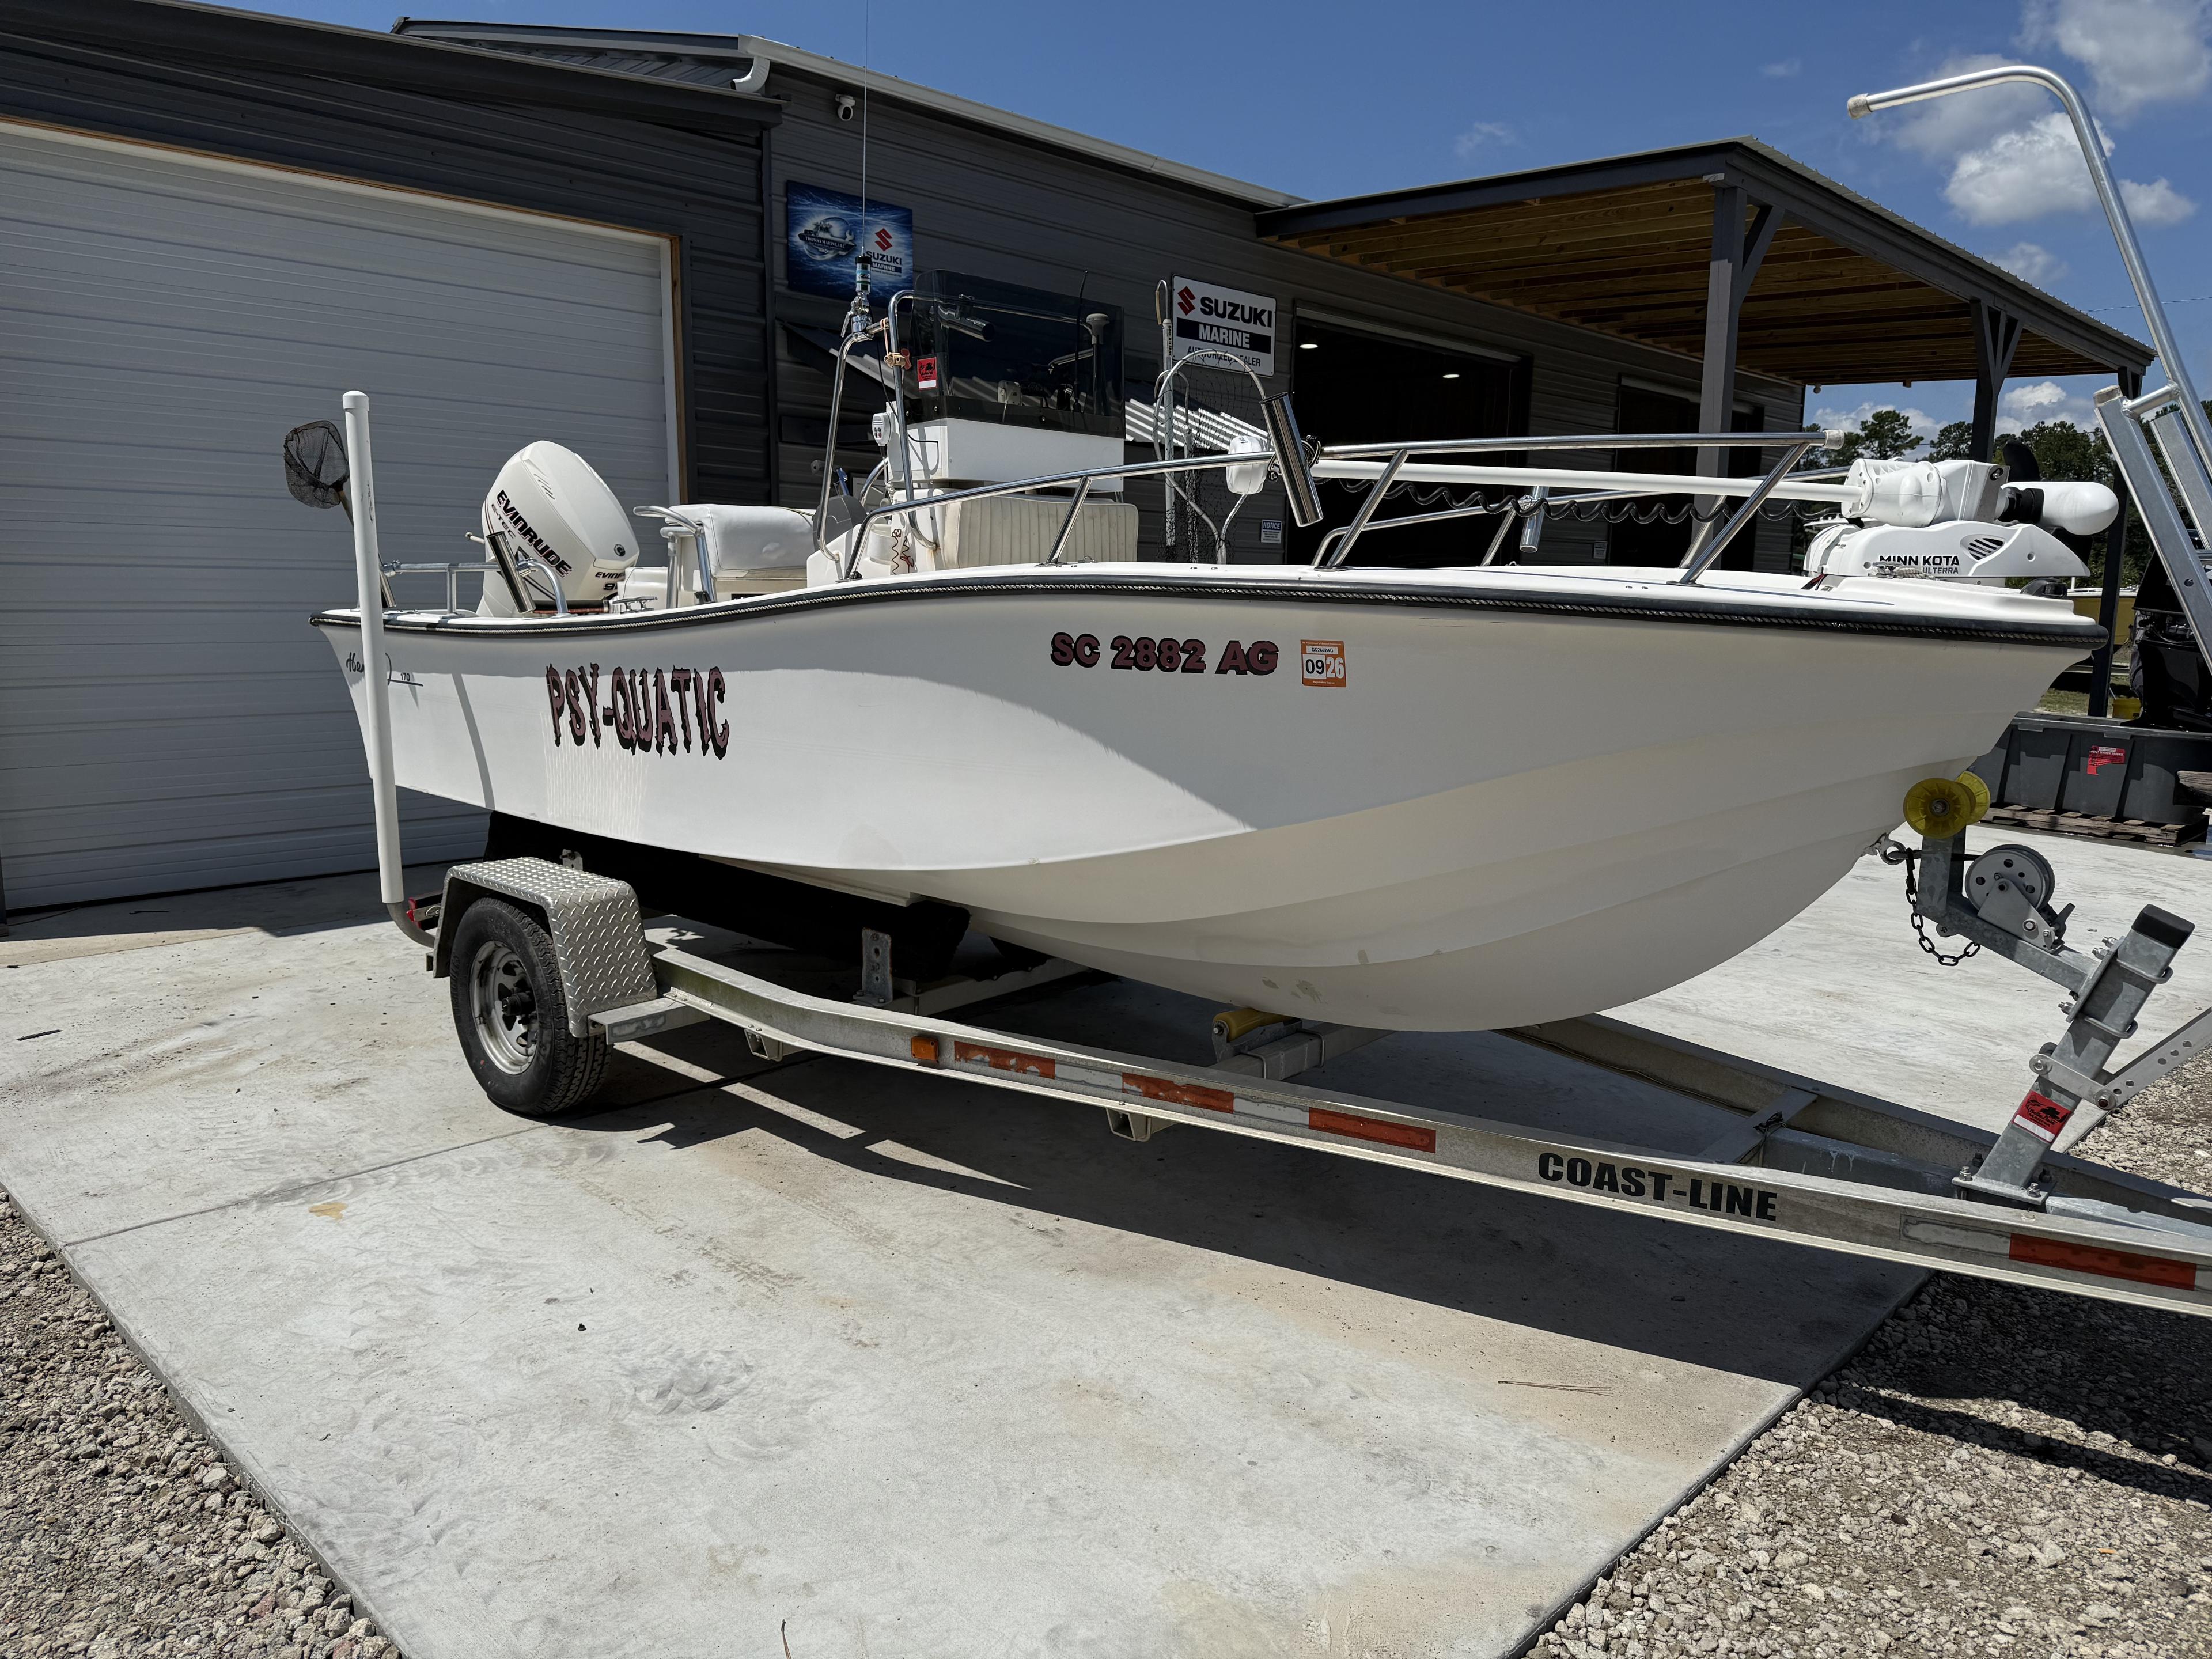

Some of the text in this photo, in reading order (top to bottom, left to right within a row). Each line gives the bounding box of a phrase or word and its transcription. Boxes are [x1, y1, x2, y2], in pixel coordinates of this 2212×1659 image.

[866, 251, 902, 265] SUZUKI
[872, 262, 895, 272] MARINE
[1200, 297, 1272, 328] SUZUKI
[1199, 324, 1250, 348] MARINE
[1234, 354, 1260, 366] EALER
[497, 490, 572, 577] EVINRUDE
[1880, 555, 1959, 566] MINN KOTA
[1050, 632, 1279, 675] SC 2882 AG
[400, 672, 410, 681] 170
[1305, 657, 1344, 679] 09 26
[546, 663, 729, 760] PSY-QUATIC
[1539, 1152, 1778, 1221] COAST-LINE
